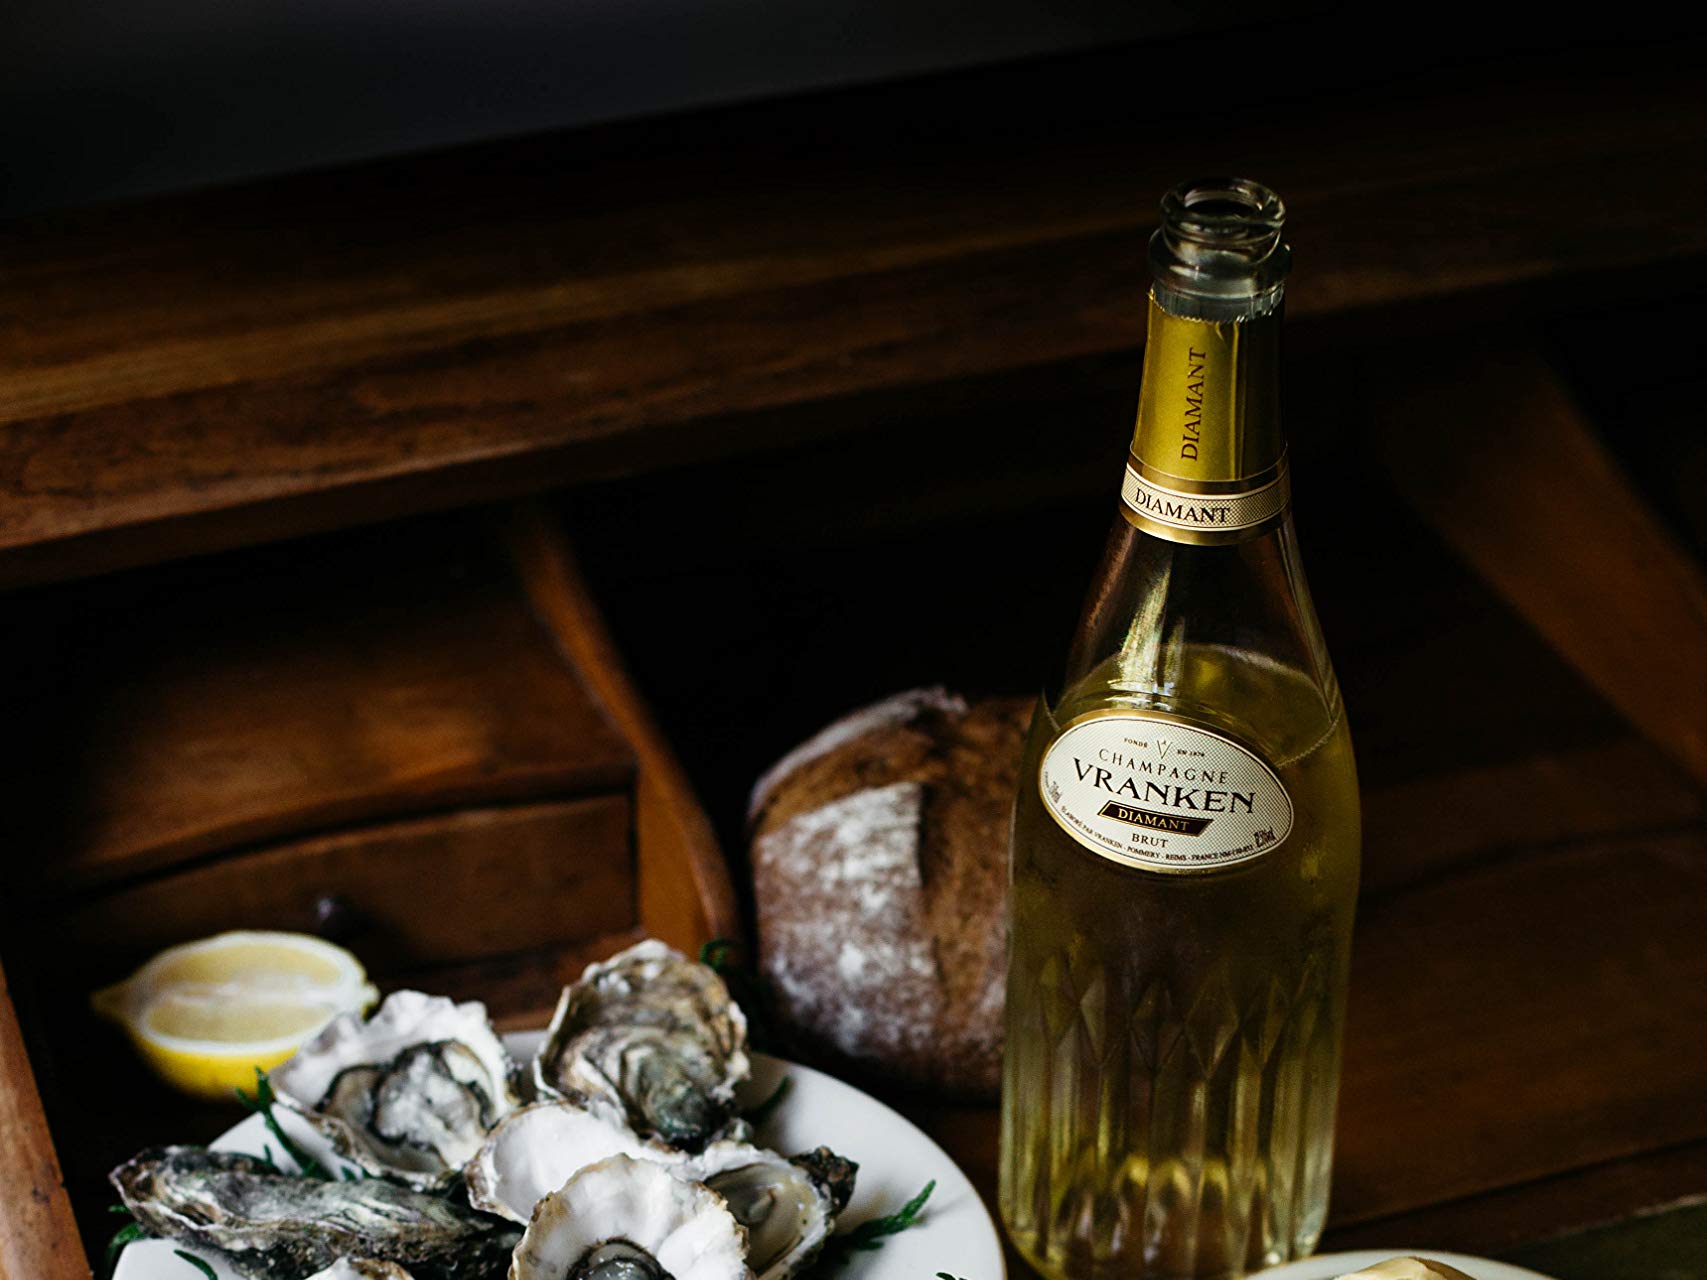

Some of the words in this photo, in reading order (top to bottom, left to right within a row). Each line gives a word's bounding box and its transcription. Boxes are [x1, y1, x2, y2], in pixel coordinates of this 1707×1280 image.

[1181, 347, 1206, 461] DIAMANT
[1135, 487, 1230, 523] DIAMANT
[1099, 749, 1228, 784] CHAMPAGNE
[1073, 757, 1256, 814] VRANKEN
[1118, 808, 1189, 831] DIAMANT
[1127, 845, 1160, 859] POMMERY
[1132, 833, 1168, 848] BRUT
